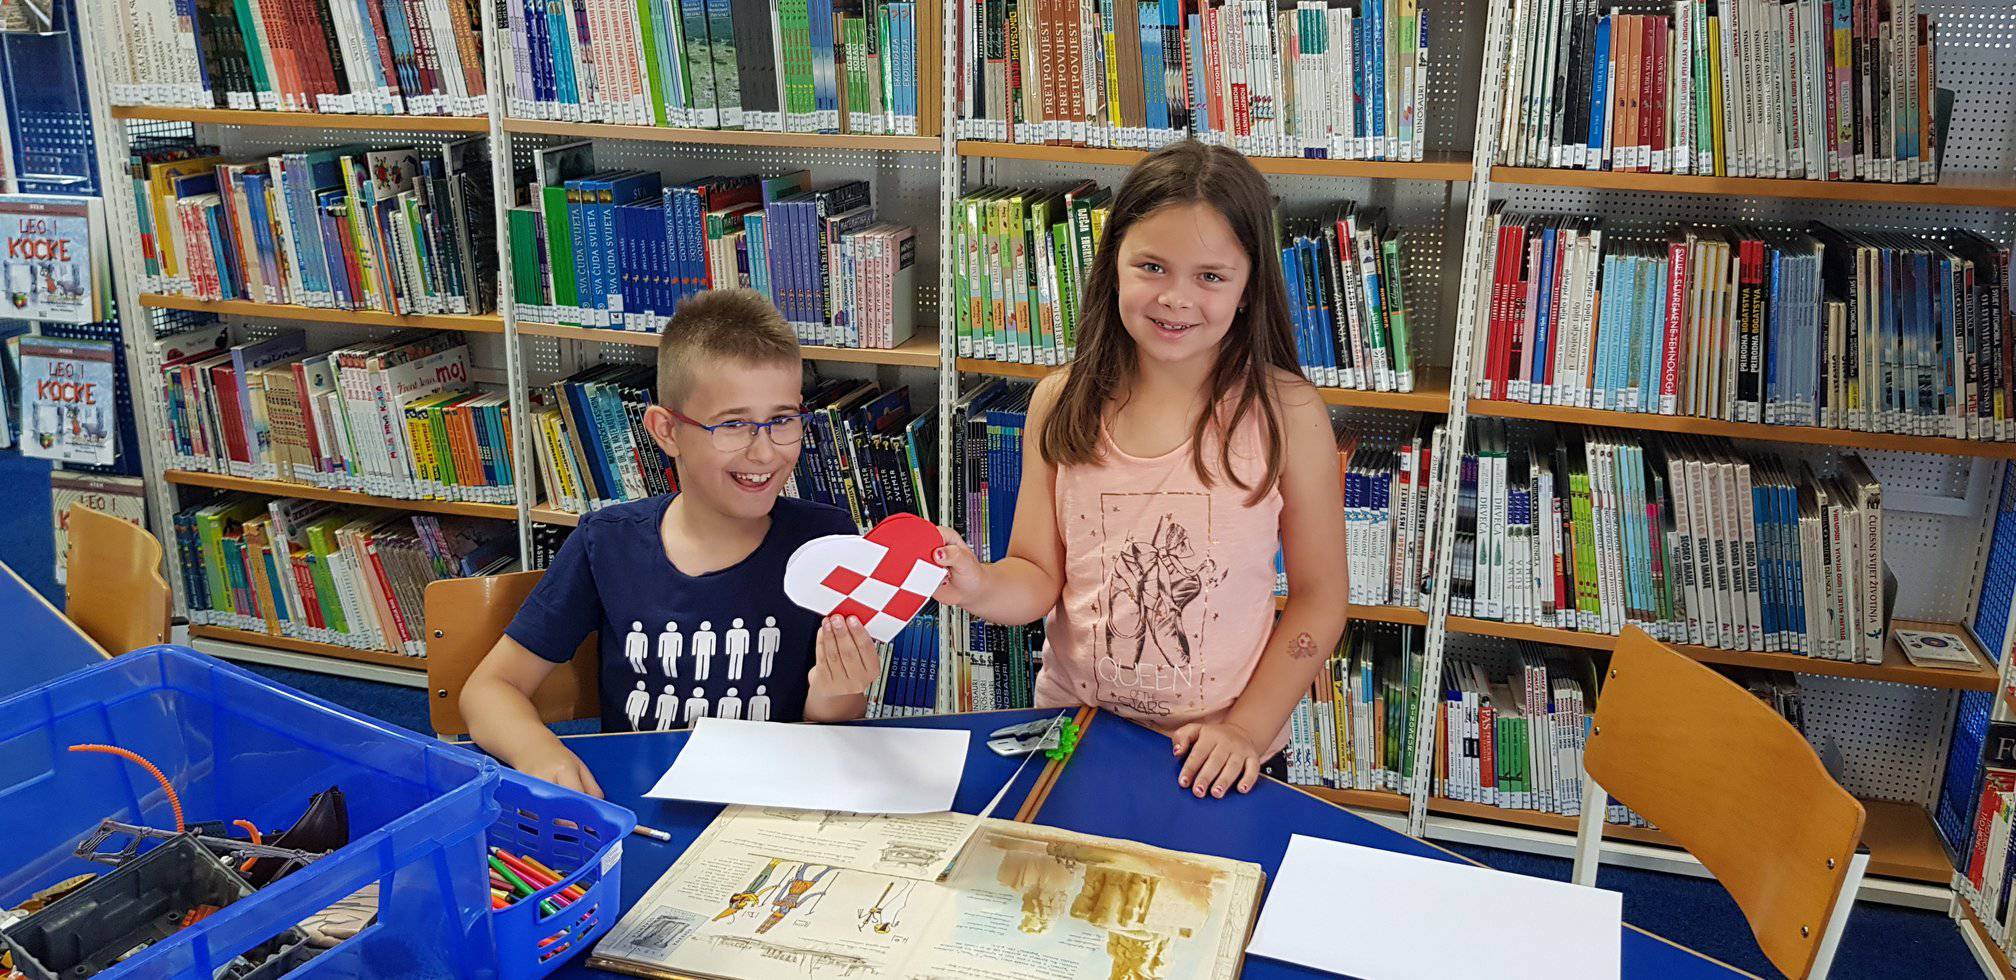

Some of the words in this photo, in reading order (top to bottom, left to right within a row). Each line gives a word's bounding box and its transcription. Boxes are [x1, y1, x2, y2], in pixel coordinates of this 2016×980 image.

[1040, 20, 1054, 114] PRETPOVIJEST
[1055, 20, 1068, 115] PRETPOVIJEST
[1069, 20, 1081, 116] PRETPOVIJEST
[1416, 85, 1425, 134] DINOSAURI
[19, 219, 45, 236] LEO
[571, 208, 582, 245] SVIJETA
[587, 209, 598, 247] SVIJETA
[603, 209, 614, 246] SVIJETA
[8, 236, 71, 262] KOCKE
[575, 249, 586, 274] ČUDA
[606, 249, 616, 274] ČUDA
[590, 249, 602, 275] ČUDA
[1059, 243, 1069, 283] priroda
[579, 278, 588, 294] SVA
[595, 279, 603, 295] SVA
[610, 278, 618, 294] SVA
[1561, 269, 1570, 295] zdravlje
[1559, 302, 1567, 320] Tijelo
[1571, 302, 1581, 322] tijelo
[1741, 288, 1750, 333] BOGATSTVA
[1752, 289, 1761, 334] BOGATSTVA
[1740, 334, 1749, 372] PRIRODNA
[1750, 335, 1759, 373] PRIRODNA
[49, 362, 74, 377] LEO
[435, 355, 467, 382] moj
[38, 379, 97, 404] KOCKE
[861, 468, 874, 499] SVEMIR
[881, 469, 893, 501] SVEMIR
[890, 470, 901, 501] SVEMIR
[901, 471, 912, 504] SVEMIR
[1399, 488, 1408, 530] INSTINKTI
[1869, 515, 1879, 551] ČUDESNI
[1699, 538, 1708, 563] SEOSKO
[1715, 540, 1724, 565] SEOSKO
[1730, 541, 1739, 566] SEOSKO
[1746, 541, 1755, 566] SEOSKO
[1701, 565, 1710, 589] IMANJE
[1866, 553, 1879, 578] SVIJET
[1717, 567, 1726, 591] IMANJE
[1733, 568, 1742, 592] IMANJE
[1748, 568, 1757, 592] IMANJE
[1869, 582, 1881, 623] ŽIVOTINJA
[891, 656, 899, 677] MORE
[900, 657, 908, 677] MORE
[909, 658, 917, 678] MORE
[919, 659, 927, 679] MORE
[1099, 656, 1193, 691] QUEEN
[1482, 709, 1492, 730] PAS
